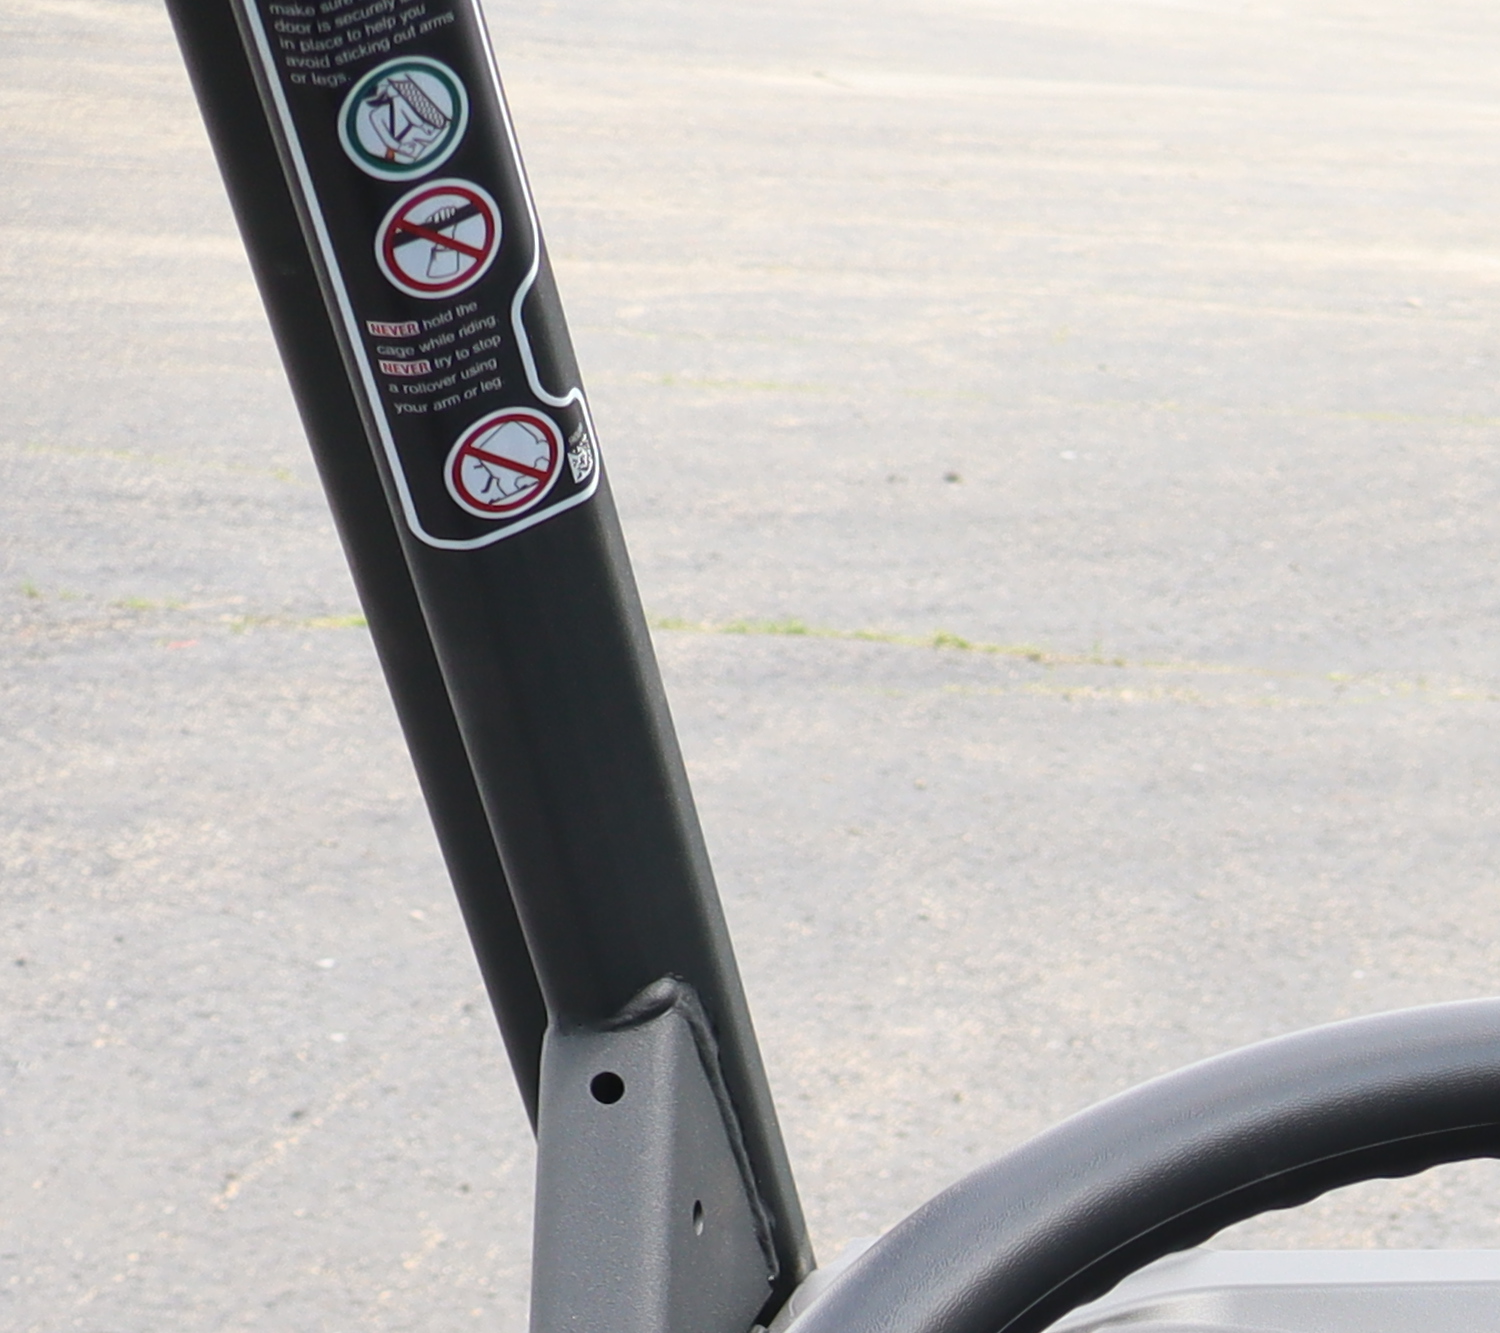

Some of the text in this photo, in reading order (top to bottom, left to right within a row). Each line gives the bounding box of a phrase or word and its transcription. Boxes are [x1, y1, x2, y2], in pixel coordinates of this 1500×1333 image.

[270, 4, 315, 16] make
[275, 20, 312, 34] door
[317, 20, 331, 32] is
[279, 4, 426, 53] in place to help you
[286, 11, 454, 68] avoid sticking out arms
[290, 72, 307, 83] or
[370, 302, 477, 336] NEVER hold the
[377, 345, 415, 358] cage
[419, 332, 455, 352] while
[382, 334, 501, 375] NEVER try to stop
[389, 358, 497, 394] a rollover using
[394, 402, 427, 414] your
[433, 394, 461, 411] arm
[464, 386, 478, 399] or
